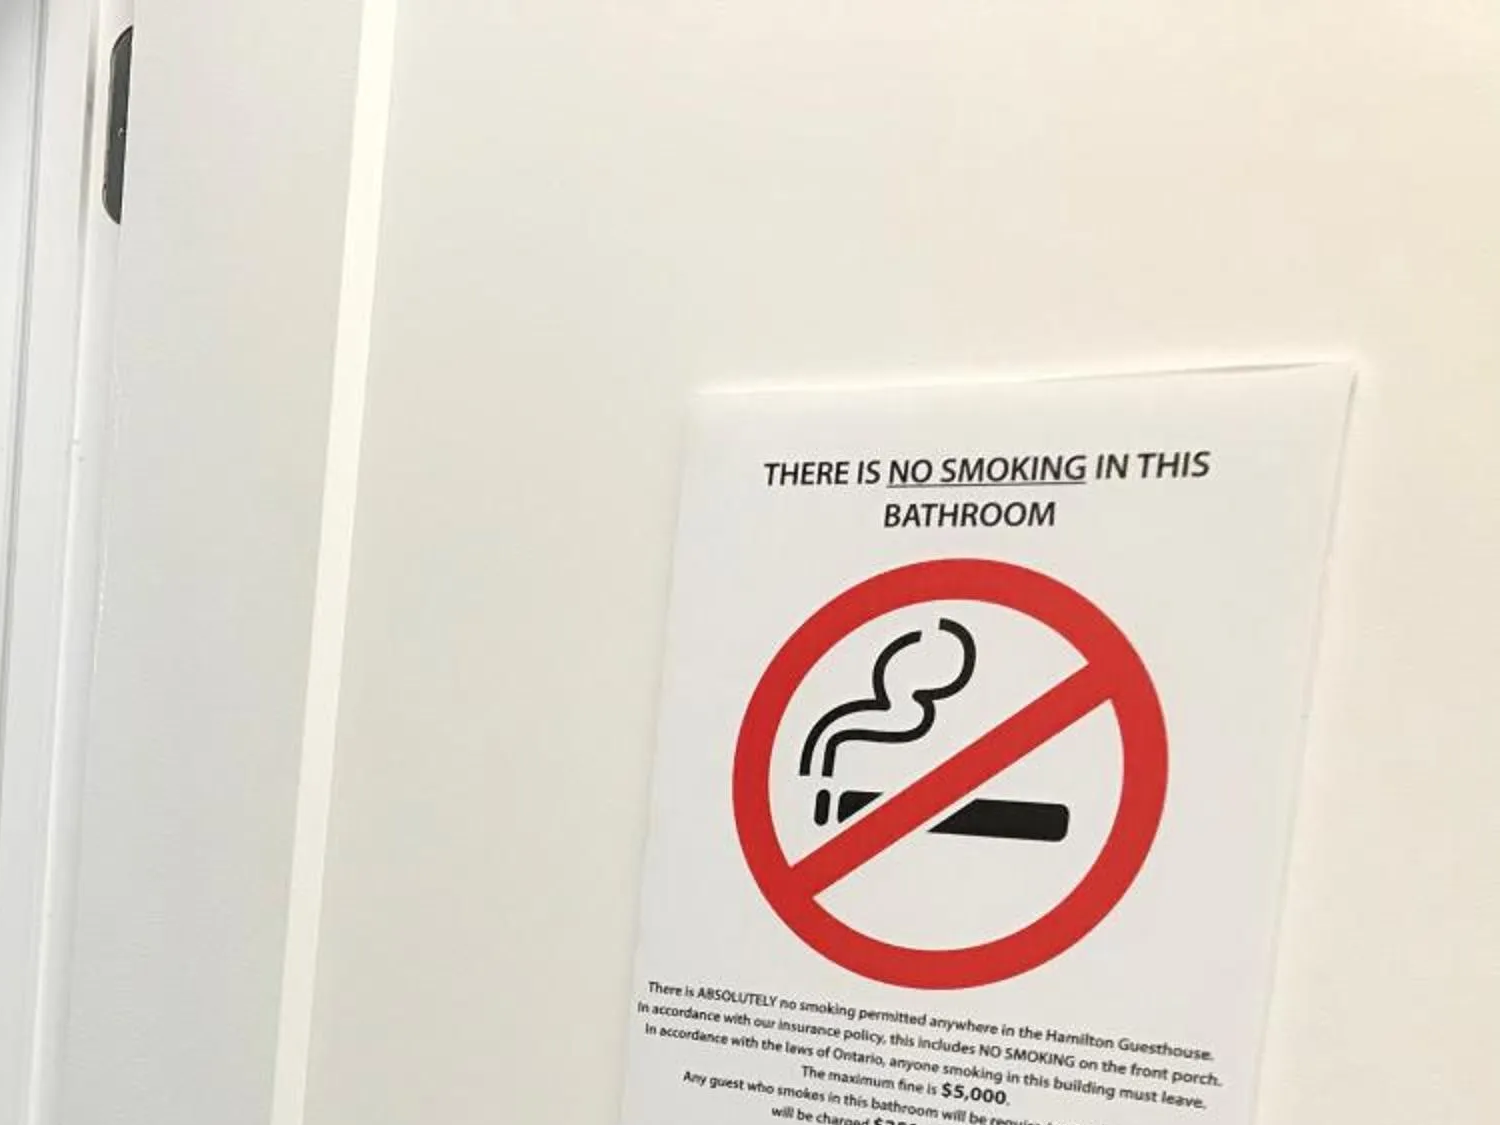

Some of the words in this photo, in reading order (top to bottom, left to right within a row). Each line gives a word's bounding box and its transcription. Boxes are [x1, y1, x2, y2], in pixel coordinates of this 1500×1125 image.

[763, 460, 850, 487] THERE
[857, 459, 881, 485] IS
[888, 458, 933, 487] NO
[939, 454, 1087, 486] SMOKING
[1095, 453, 1130, 480] IN
[1136, 450, 1211, 479] THIS
[883, 501, 1056, 528] BATHROOM
[637, 1000, 650, 1014] In
[651, 1005, 722, 1023] accordance
[723, 1012, 752, 1027] with
[753, 1017, 776, 1029] our
[777, 1018, 842, 1039] insurance
[842, 1028, 887, 1047] policy,
[889, 1033, 915, 1048] this
[917, 1035, 976, 1056] includes
[978, 1043, 1003, 1059] NO
[1004, 1047, 1076, 1069] SMOKING
[1078, 1059, 1099, 1071] on
[1101, 1059, 1128, 1076] the
[1129, 1062, 1169, 1081] front
[1171, 1071, 1222, 1087] porch.
[647, 980, 683, 997] There
[684, 985, 695, 998] is
[696, 986, 779, 1008] ABSOLUTELY
[779, 998, 798, 1011] no
[799, 1001, 857, 1021] smoking
[857, 1009, 928, 1027] permitted
[928, 1017, 999, 1035] anywhere
[1000, 1023, 1016, 1038] in
[1018, 1025, 1044, 1041] the
[1045, 1028, 1115, 1049] Hamilton
[1117, 1037, 1214, 1061] Guesthouse.
[644, 1022, 657, 1036] In
[658, 1026, 729, 1045] accordance
[730, 1035, 760, 1049] with
[761, 1038, 784, 1053] the
[784, 1040, 814, 1057] laws
[815, 1045, 832, 1059] of
[832, 1047, 886, 1068] Ontario,
[888, 1057, 941, 1074] anyone
[942, 1064, 1004, 1086] smoking
[1005, 1070, 1021, 1085] in
[1022, 1073, 1051, 1089] this
[1053, 1075, 1117, 1101] building
[1118, 1088, 1159, 1103] must
[1160, 1090, 1207, 1110] leave.
[801, 1065, 827, 1081] The
[827, 1071, 895, 1090] maximum
[897, 1078, 925, 1094] fine
[926, 1083, 938, 1096] is
[941, 1081, 1010, 1106] $5,000.
[683, 1070, 708, 1088] Any
[709, 1076, 745, 1091] guest
[746, 1080, 775, 1095] who
[777, 1086, 826, 1103] smokes
[827, 1091, 842, 1105] in
[843, 1093, 869, 1109] this
[870, 1096, 939, 1119] bathroom
[941, 1109, 968, 1123] will
[771, 1105, 795, 1119] will
[796, 1108, 814, 1123] be
